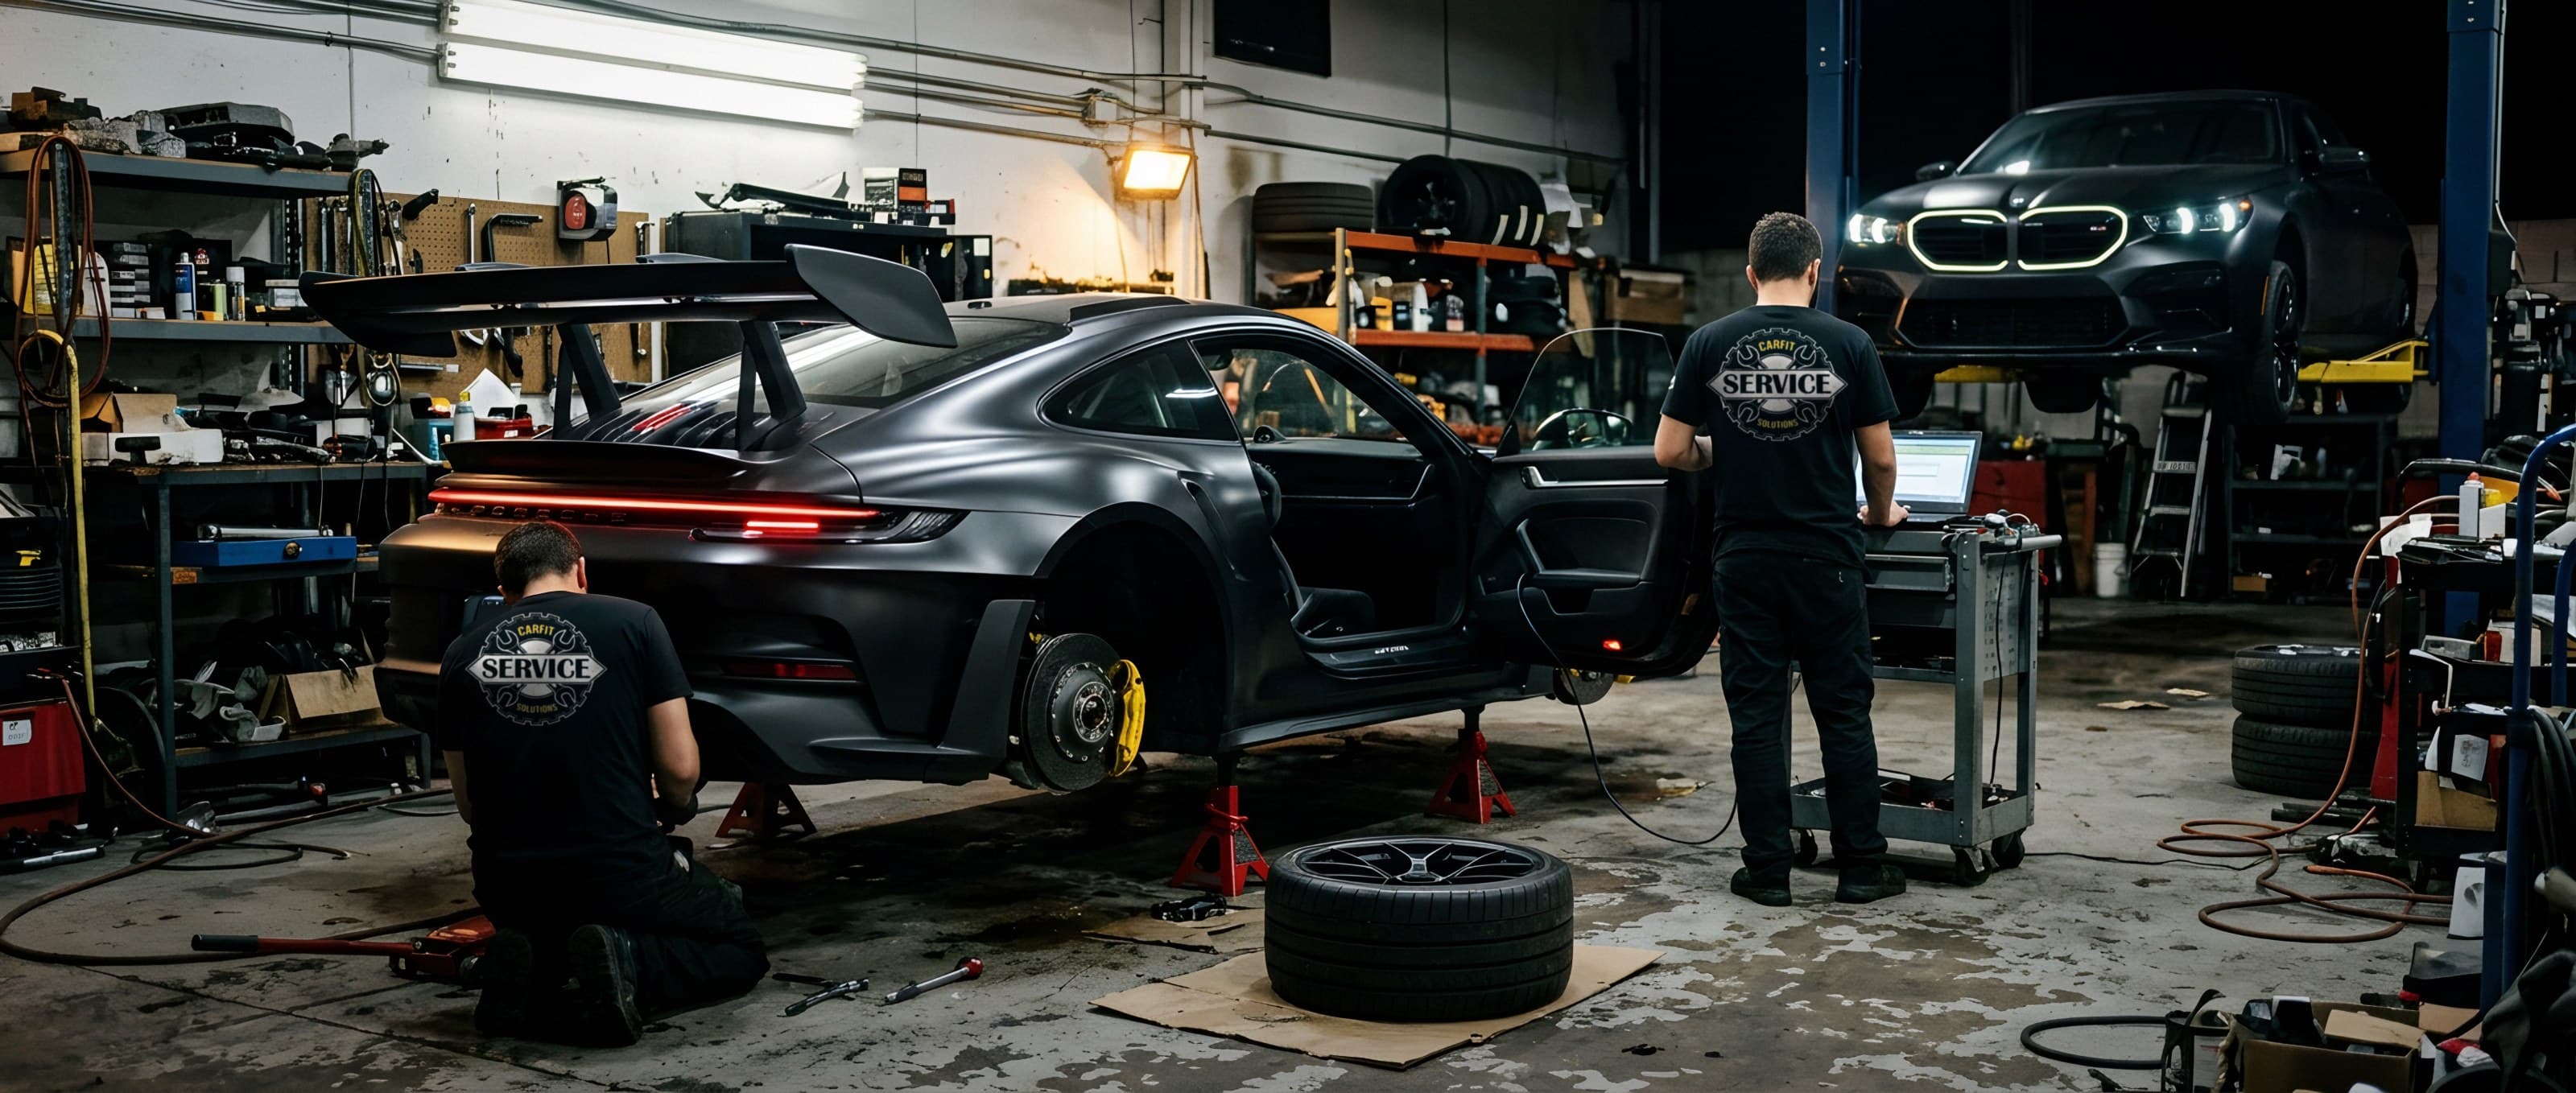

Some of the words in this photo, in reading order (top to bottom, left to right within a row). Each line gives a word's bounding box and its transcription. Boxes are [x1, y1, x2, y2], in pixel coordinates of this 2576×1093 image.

[1758, 339, 1796, 352] CARFIT
[1723, 373, 1832, 394] SERVICE
[1757, 418, 1799, 429] SOLUTIONS
[517, 624, 555, 637] CARFIT
[482, 658, 591, 679] SERVICE
[516, 703, 559, 713] SOLUTIONS
